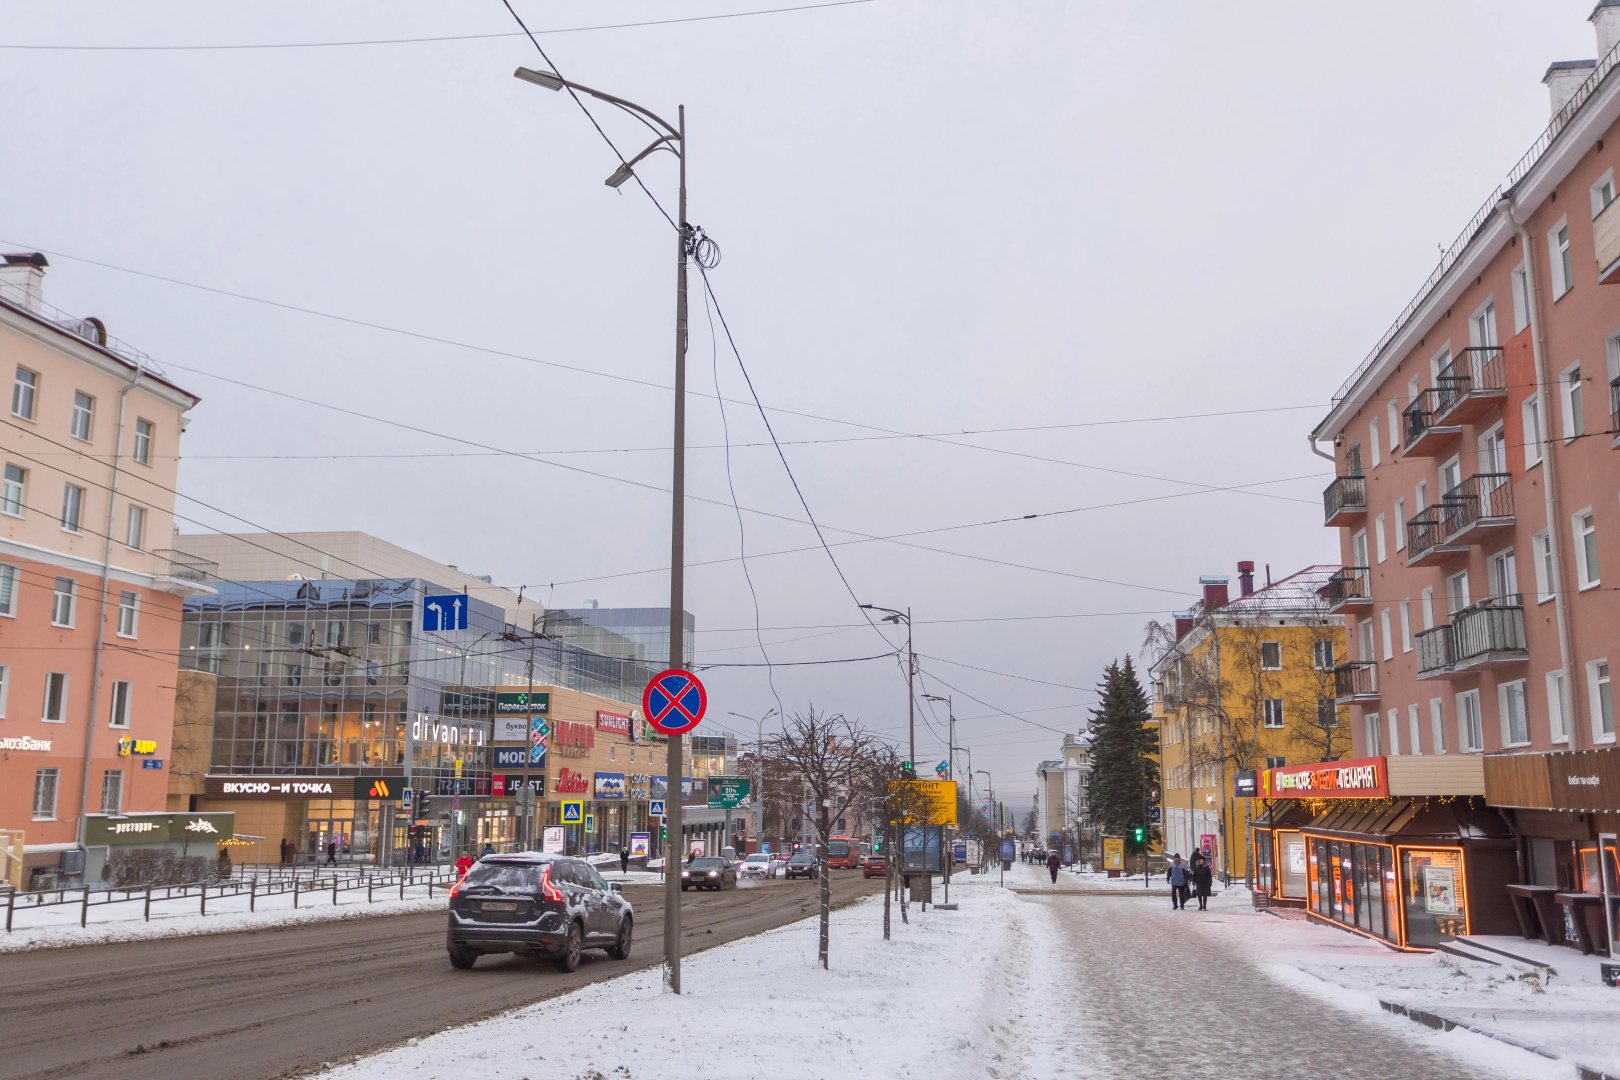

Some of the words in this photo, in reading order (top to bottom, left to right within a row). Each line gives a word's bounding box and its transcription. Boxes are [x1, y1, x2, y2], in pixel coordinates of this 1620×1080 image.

[600, 713, 629, 732] SUNLIGHT
[134, 740, 157, 754] ЛДПР
[223, 783, 270, 793] ВКУСНО
[292, 783, 333, 793] ТОЧКА
[508, 780, 543, 791] JEST.
